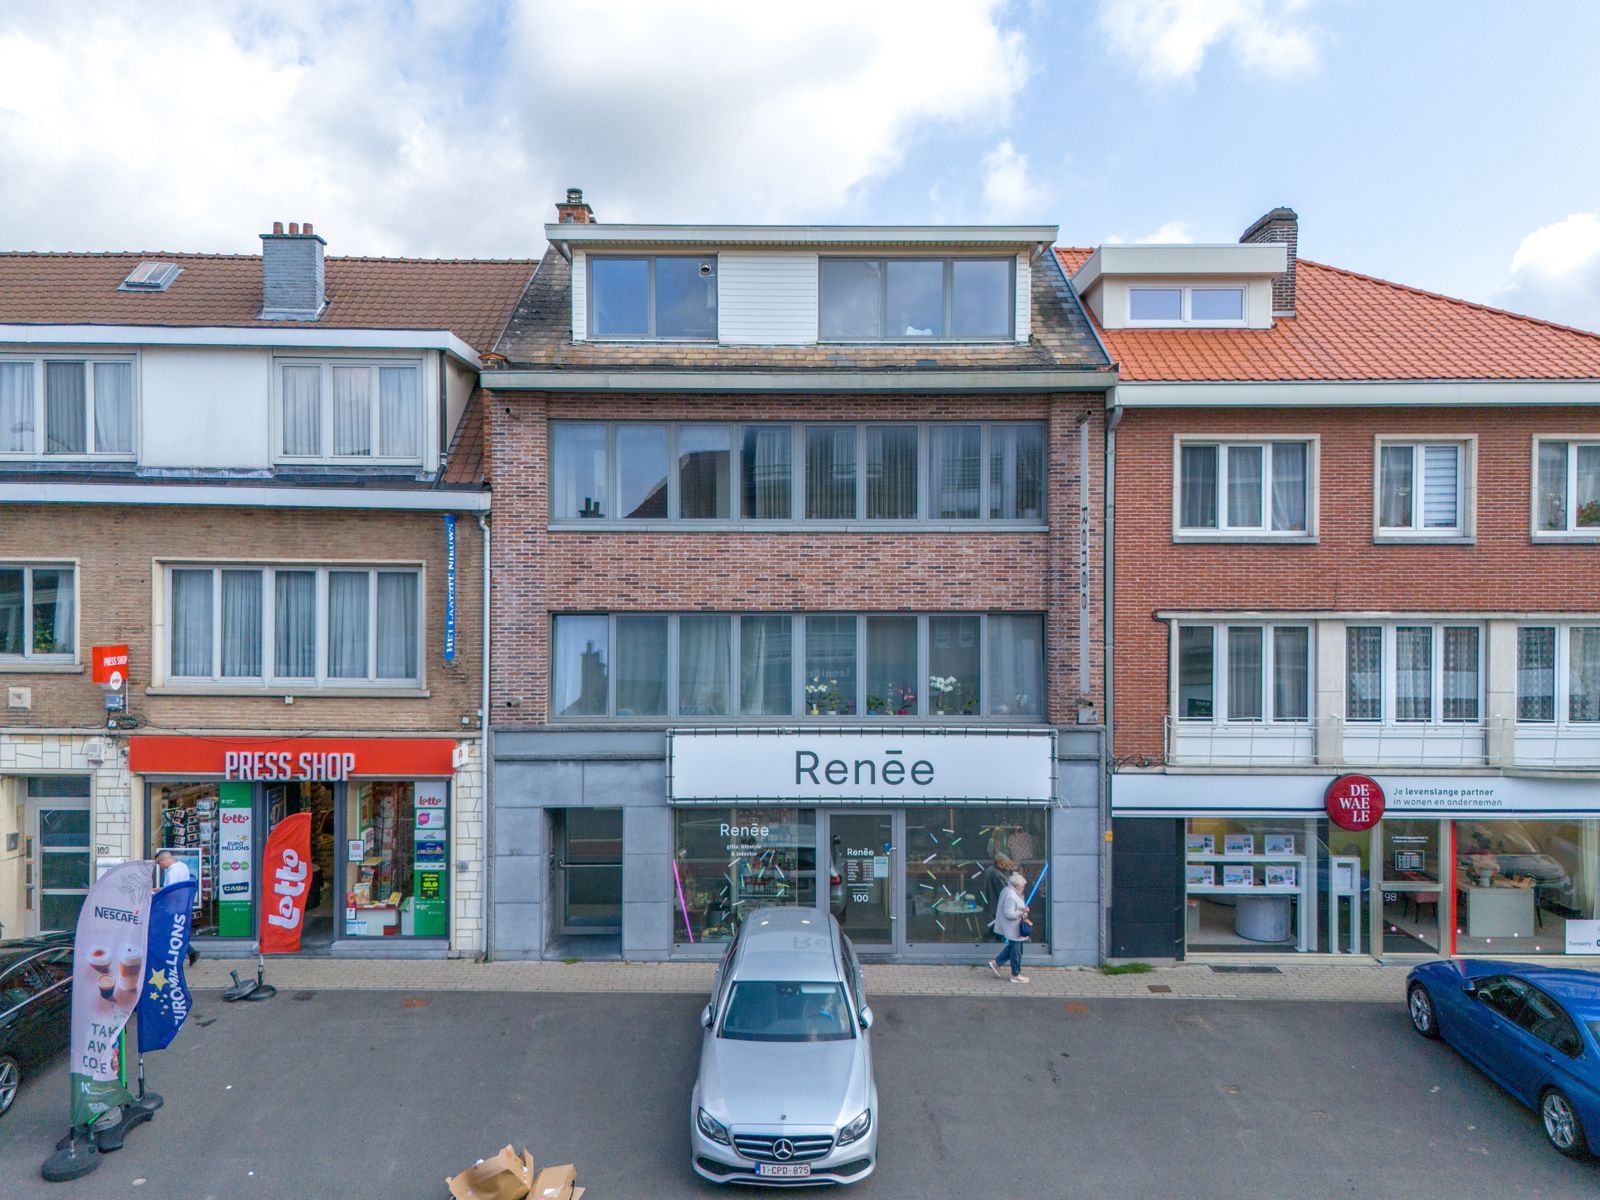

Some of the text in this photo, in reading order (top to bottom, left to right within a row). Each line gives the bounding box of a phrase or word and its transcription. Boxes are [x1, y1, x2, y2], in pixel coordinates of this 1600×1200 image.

[103, 657, 117, 667] PRESS
[224, 750, 356, 782] PRESS SHOP
[1349, 784, 1370, 797] DE
[1392, 786, 1494, 799] Je levenslange partner
[1338, 797, 1370, 810] WAE
[1392, 797, 1502, 807] in wonen en ondernemen
[222, 812, 250, 824] Lotto
[1352, 811, 1370, 823] LE
[97, 846, 110, 855] 102
[268, 848, 307, 929] Lotto
[852, 894, 869, 903] 100
[1384, 892, 1398, 902] 98
[761, 1165, 810, 1175] 1-CPD-875
